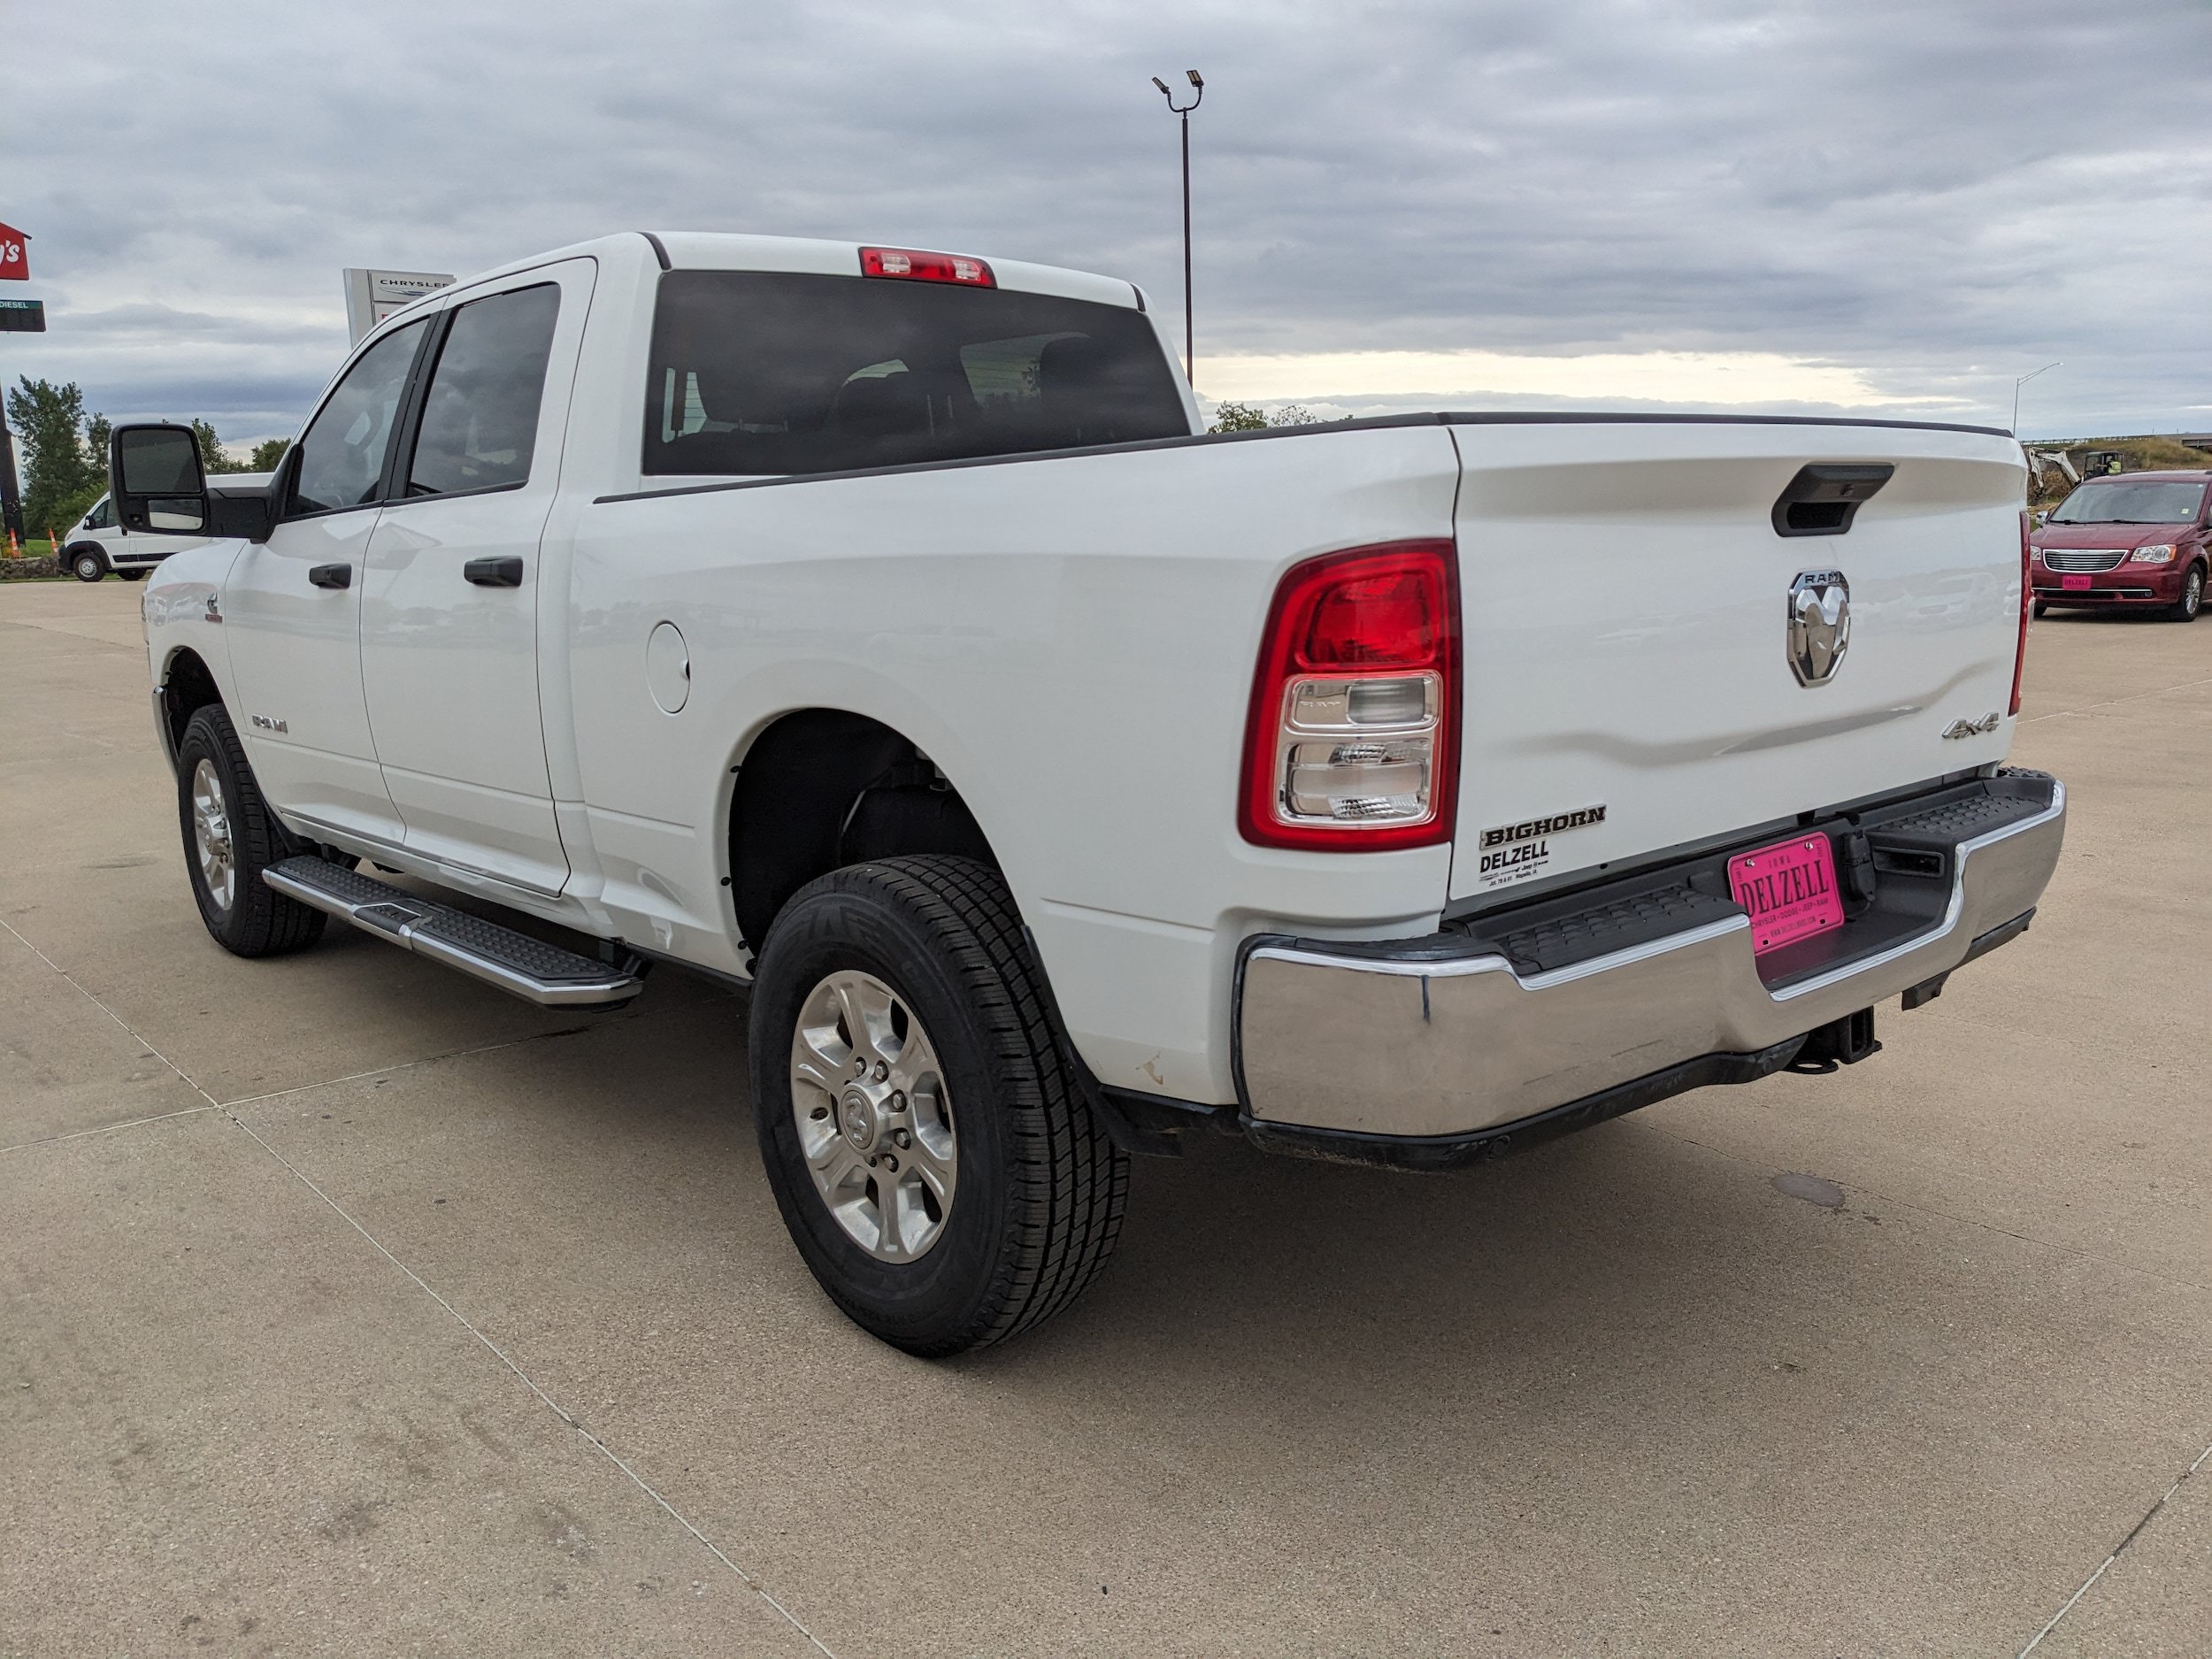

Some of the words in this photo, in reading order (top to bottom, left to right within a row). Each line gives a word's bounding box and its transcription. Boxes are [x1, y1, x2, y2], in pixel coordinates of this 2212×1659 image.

[1805, 573, 1841, 584] RAM
[251, 713, 288, 733] RAM
[1482, 804, 1607, 849] BIGHORN
[1479, 840, 1549, 874] DELZELL
[1740, 859, 1830, 918] DELZELL
[1802, 902, 1813, 911] JEEP
